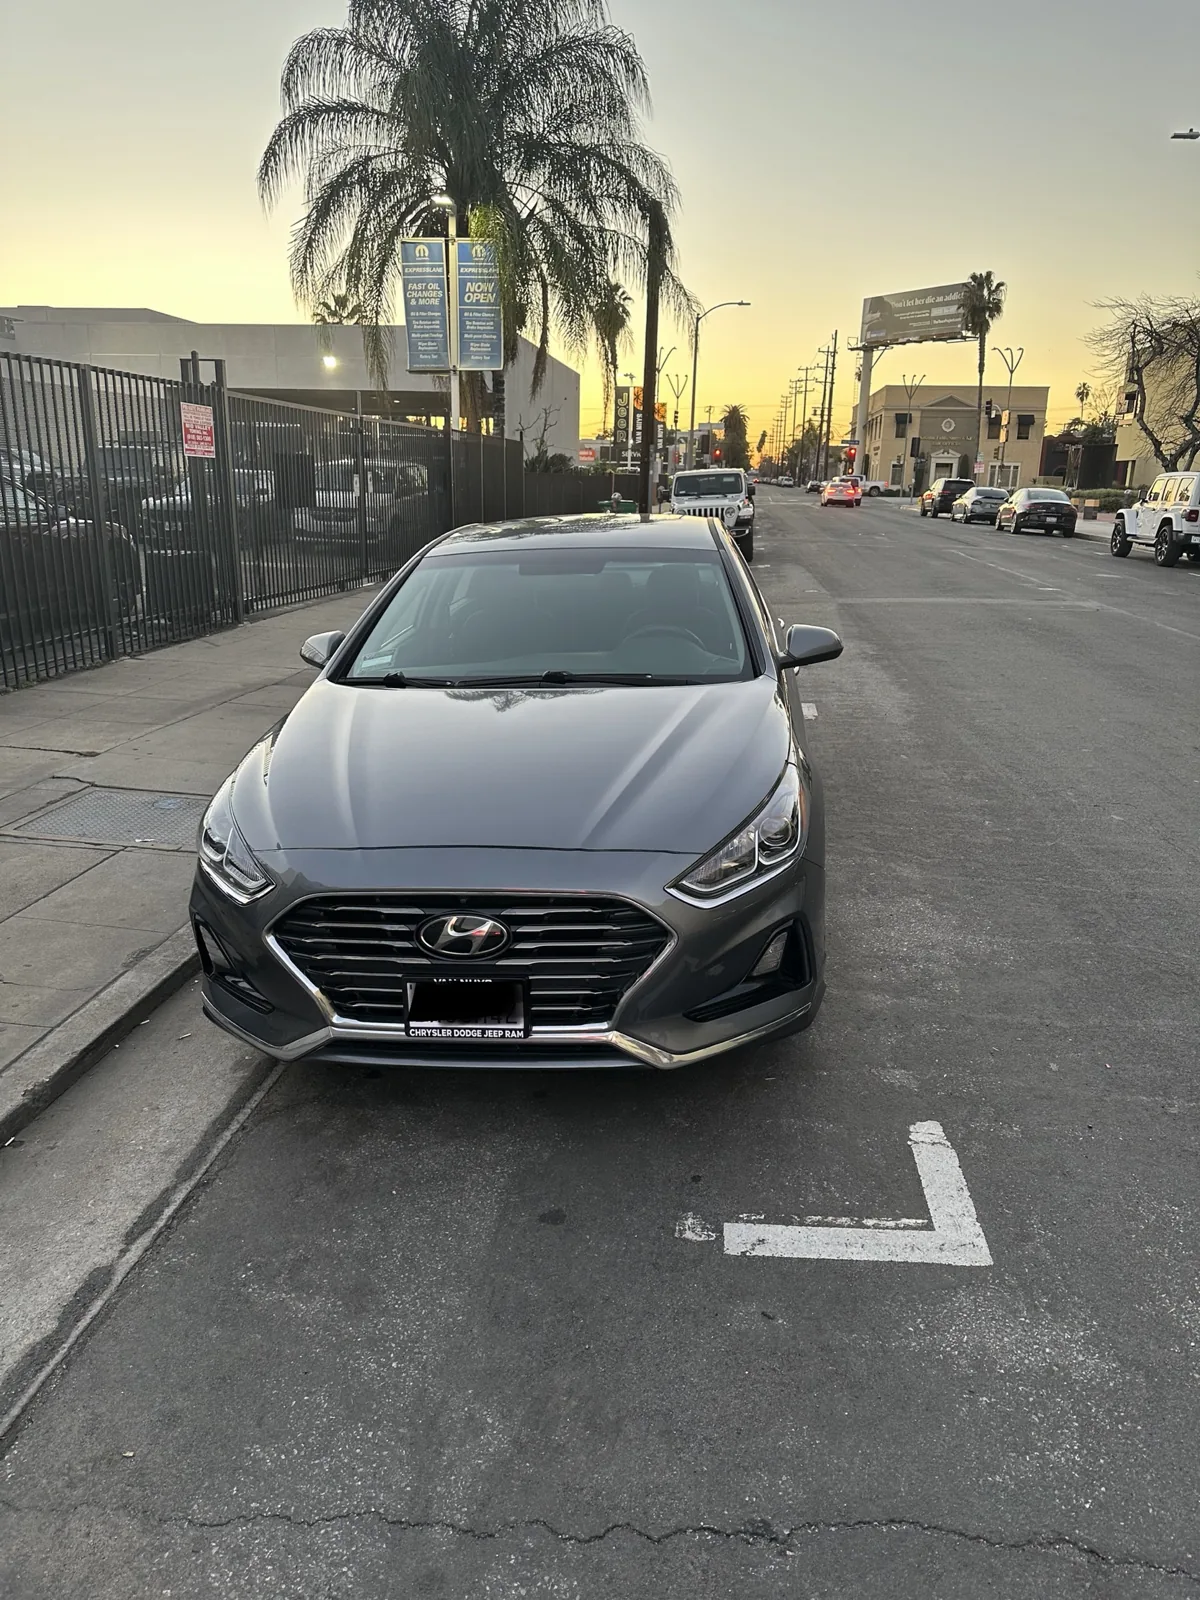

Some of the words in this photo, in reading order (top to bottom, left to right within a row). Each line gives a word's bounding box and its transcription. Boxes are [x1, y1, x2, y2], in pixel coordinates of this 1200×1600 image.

[466, 282, 494, 292] NOW
[464, 293, 496, 302] OPEN
[925, 296, 935, 304] die
[616, 392, 628, 442] Jeep
[410, 1029, 452, 1037] CHRYSLER
